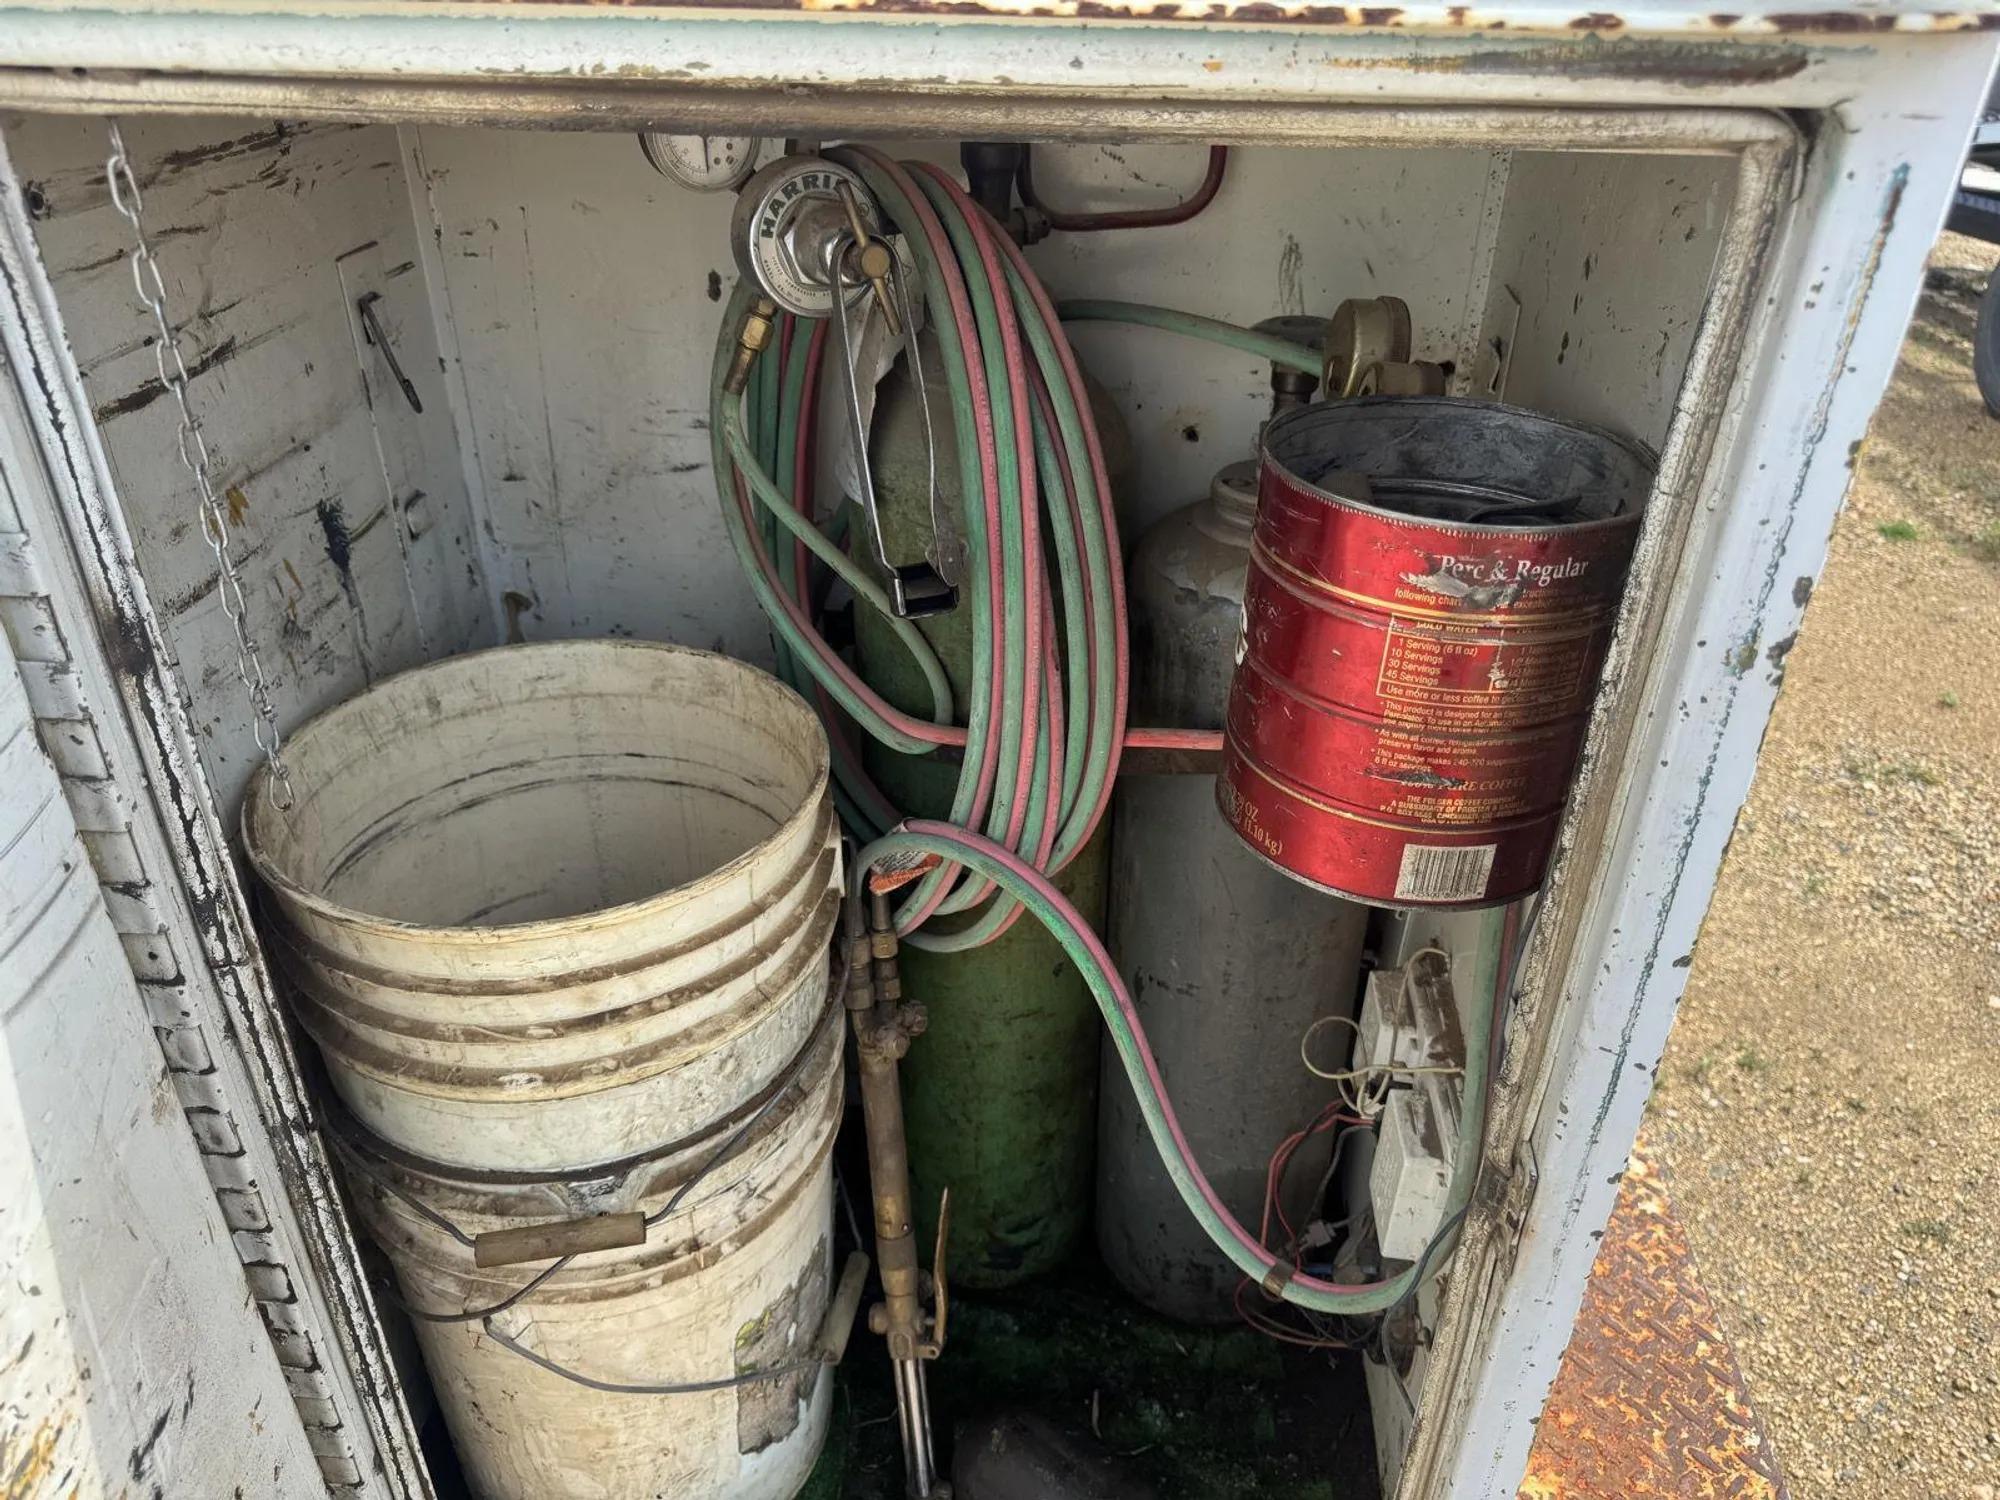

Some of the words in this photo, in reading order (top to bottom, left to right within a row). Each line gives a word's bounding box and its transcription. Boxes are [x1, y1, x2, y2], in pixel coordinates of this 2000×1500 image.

[1440, 555, 1485, 580] Perc
[1489, 560, 1509, 581] &
[1515, 557, 1589, 587] Regular
[1395, 587, 1437, 605] following
[1406, 639, 1441, 653] Serving
[1391, 647, 1403, 657] 10
[1404, 649, 1443, 665] Servings
[1388, 657, 1400, 668] 30
[1401, 660, 1441, 675] Servings
[1386, 669, 1398, 679] 45
[1400, 671, 1439, 686] Servings
[1386, 683, 1404, 695] Use
[1405, 687, 1429, 699] more
[1443, 693, 1460, 702] less
[1462, 694, 1489, 704] coffee
[1264, 831, 1283, 856] kg)
